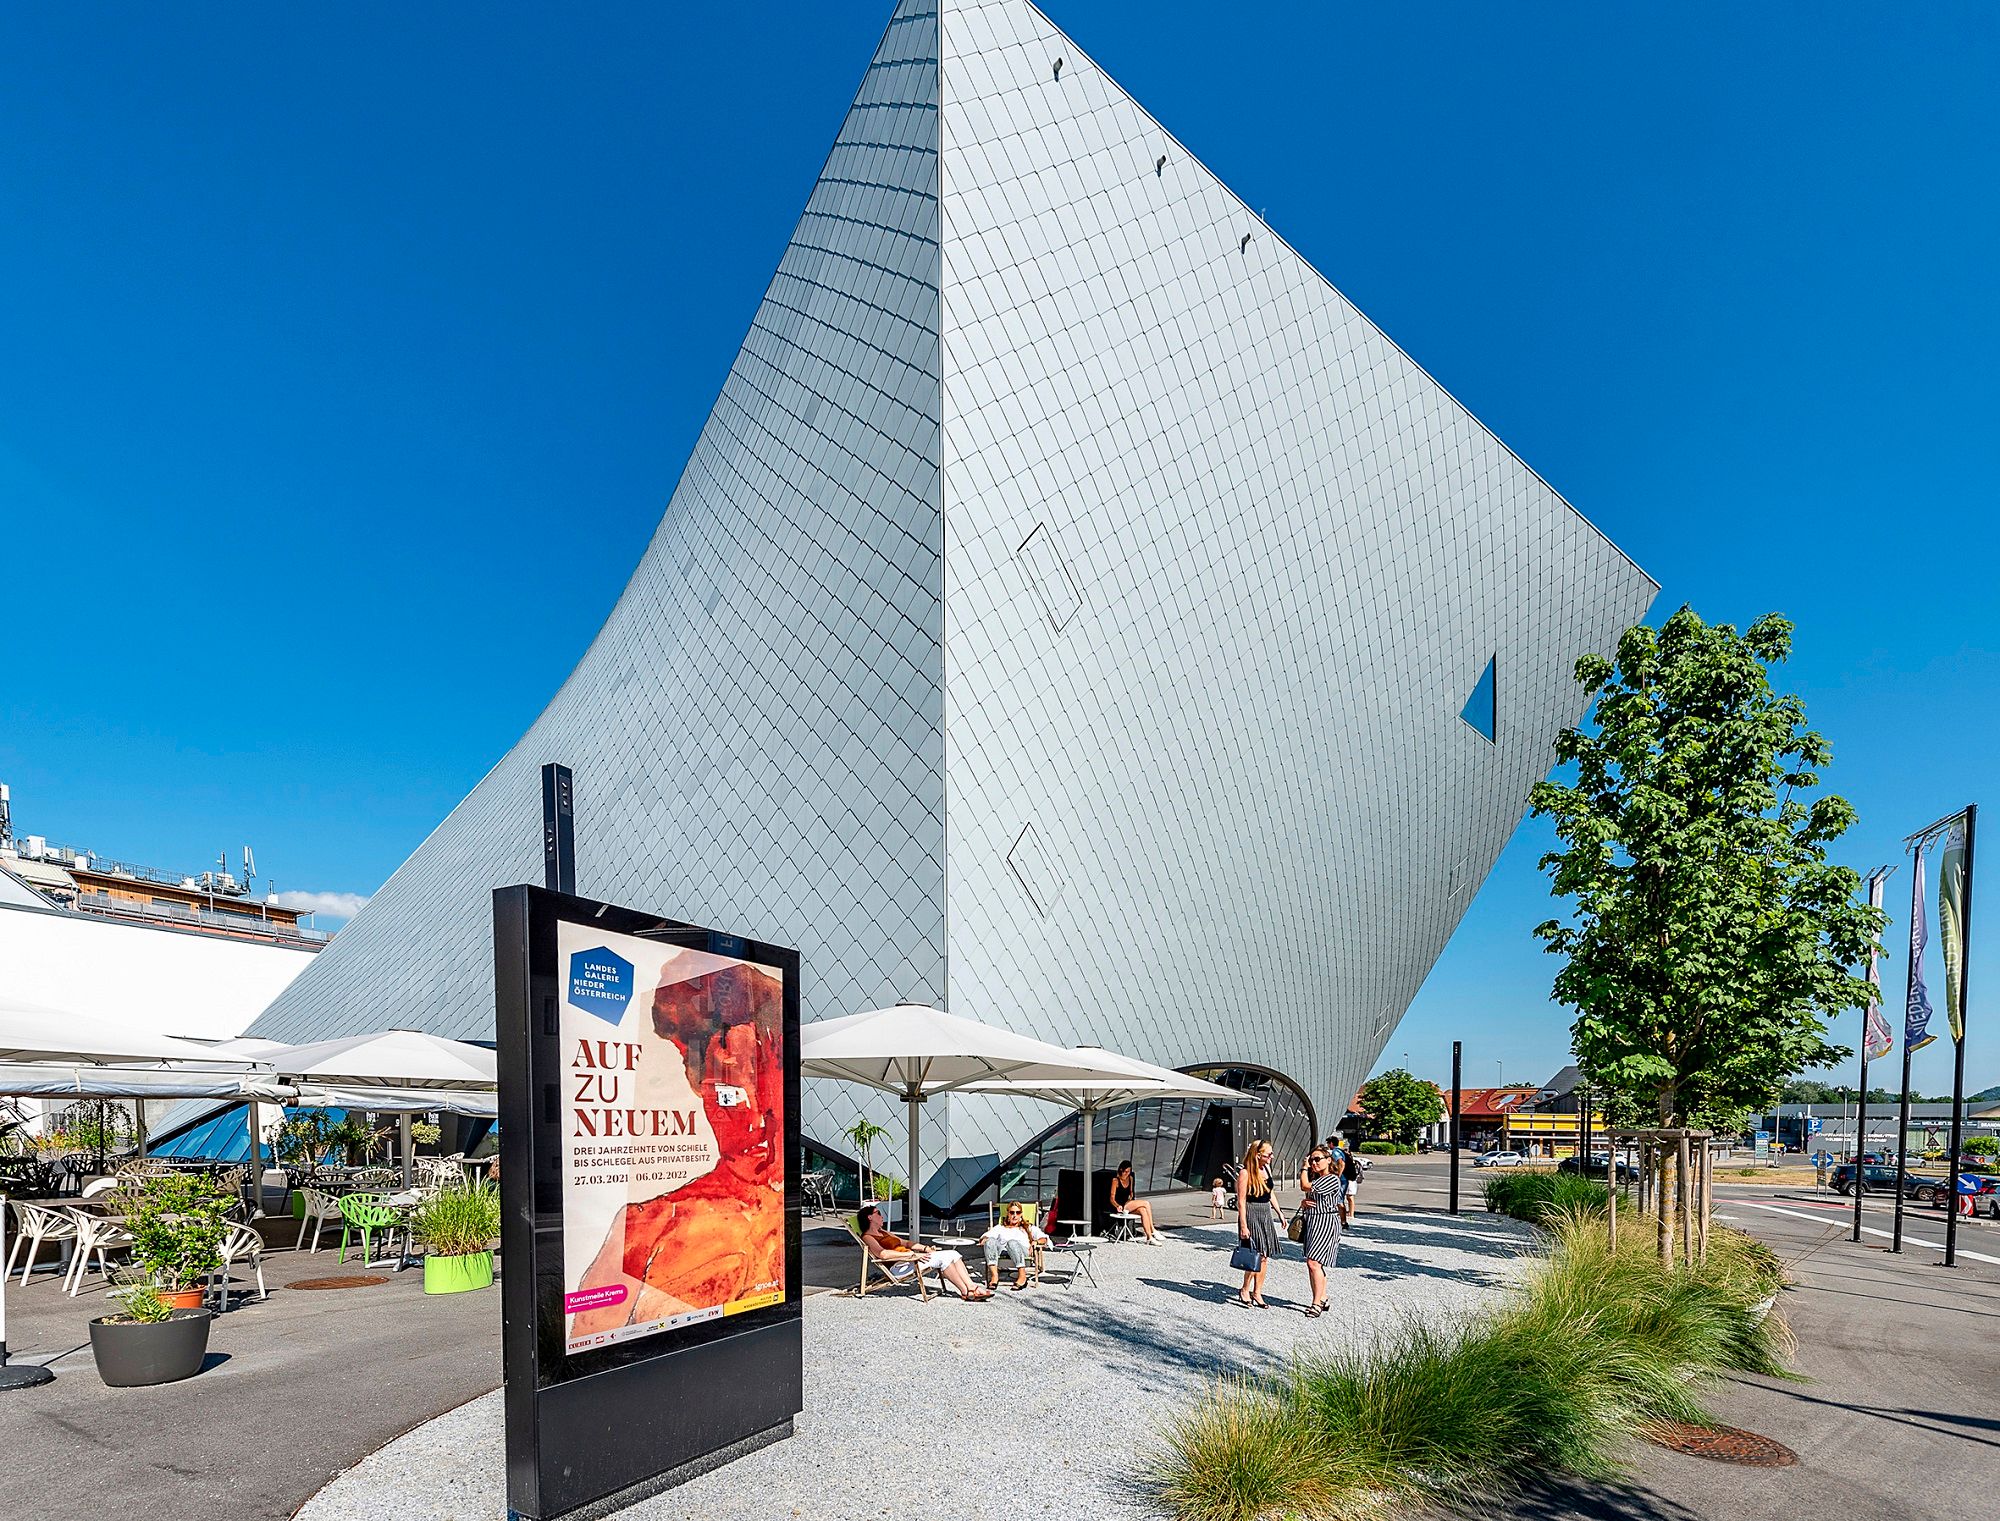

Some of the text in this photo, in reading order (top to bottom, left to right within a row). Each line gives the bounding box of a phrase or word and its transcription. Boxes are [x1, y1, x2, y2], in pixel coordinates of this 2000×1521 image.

[584, 962, 617, 975] LANDES
[573, 978, 605, 990] NIEDER
[584, 970, 620, 983] GALERIE
[574, 986, 626, 1001] ÖSTERREICH
[571, 1038, 643, 1071] AUF
[574, 1073, 618, 1103] ZU
[573, 1108, 697, 1137] NEUEM
[573, 1143, 708, 1156] DREI JAHRZEHNTE VON SCHIELE
[573, 1154, 711, 1168] BIS SCHLEGEL AUS PRIVATBESITZ
[574, 1170, 687, 1186] 27.03.2021 06.02.2022
[569, 1289, 624, 1304] Kunstmeile Krems
